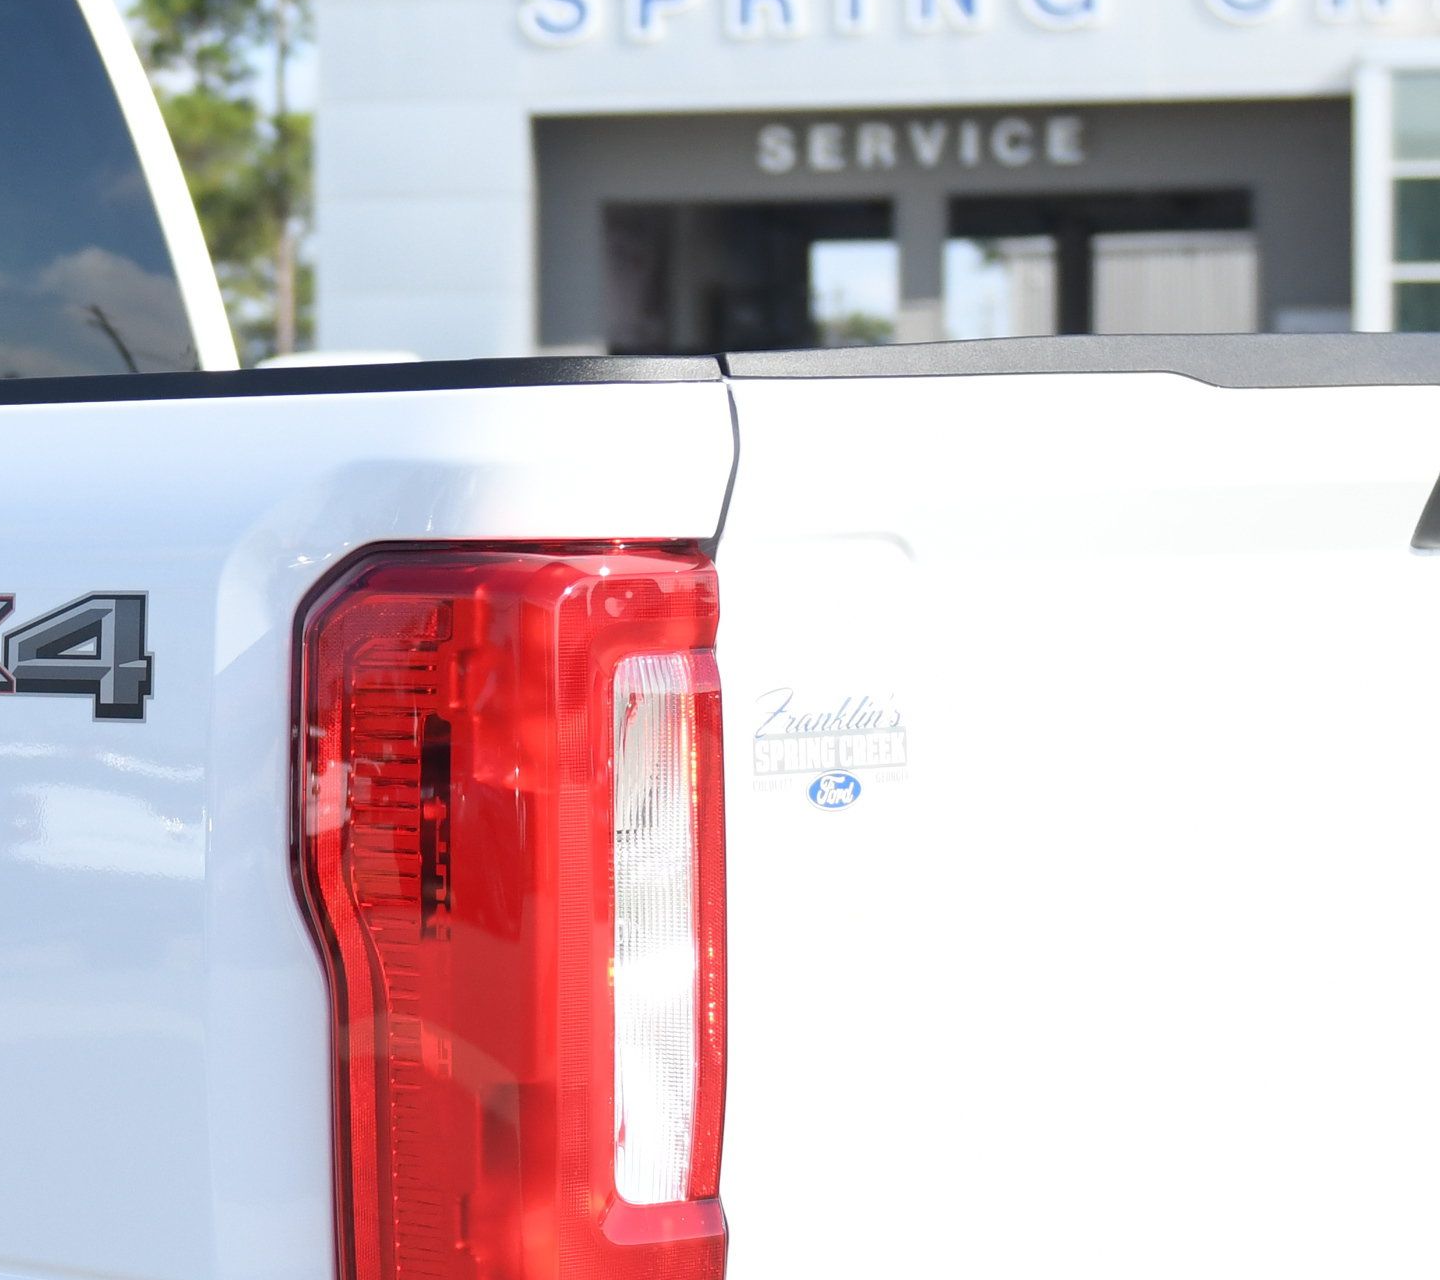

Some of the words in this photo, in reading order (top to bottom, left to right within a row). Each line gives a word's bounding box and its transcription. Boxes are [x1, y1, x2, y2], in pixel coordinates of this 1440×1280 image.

[756, 114, 1087, 173] SERVICE
[755, 738, 836, 773] SPRING
[839, 732, 906, 767] CREEK
[816, 775, 855, 805] Ford
